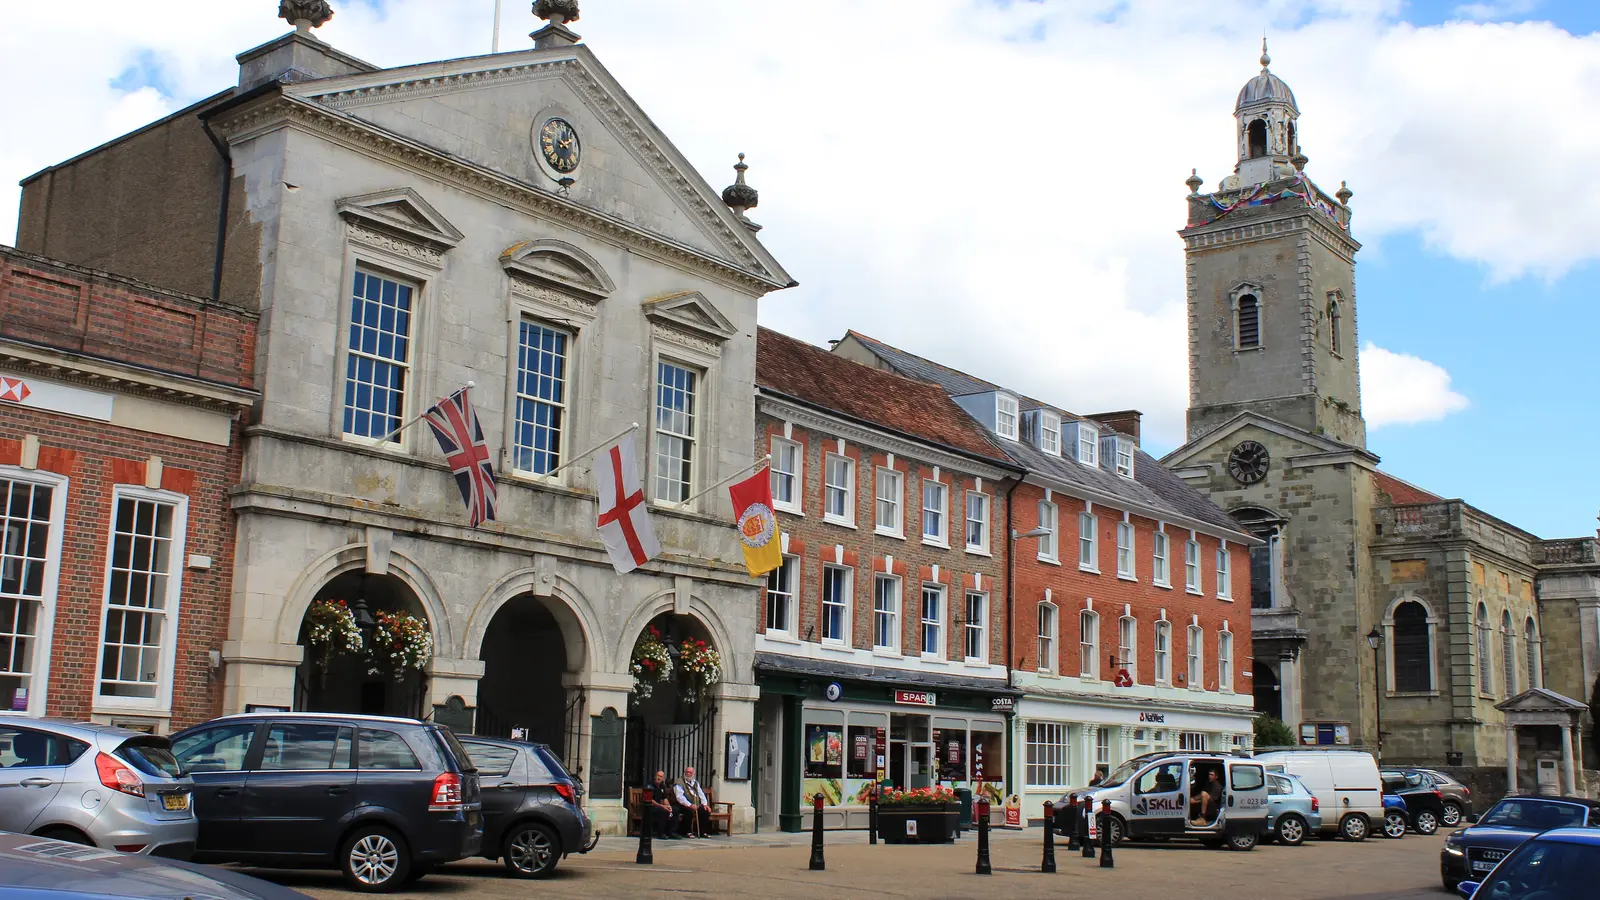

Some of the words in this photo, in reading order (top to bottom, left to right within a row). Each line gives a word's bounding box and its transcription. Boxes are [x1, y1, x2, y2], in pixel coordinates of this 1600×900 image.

[902, 692, 927, 702] SPAR
[1144, 712, 1165, 723] NatWest
[1149, 799, 1183, 810] SKILL
